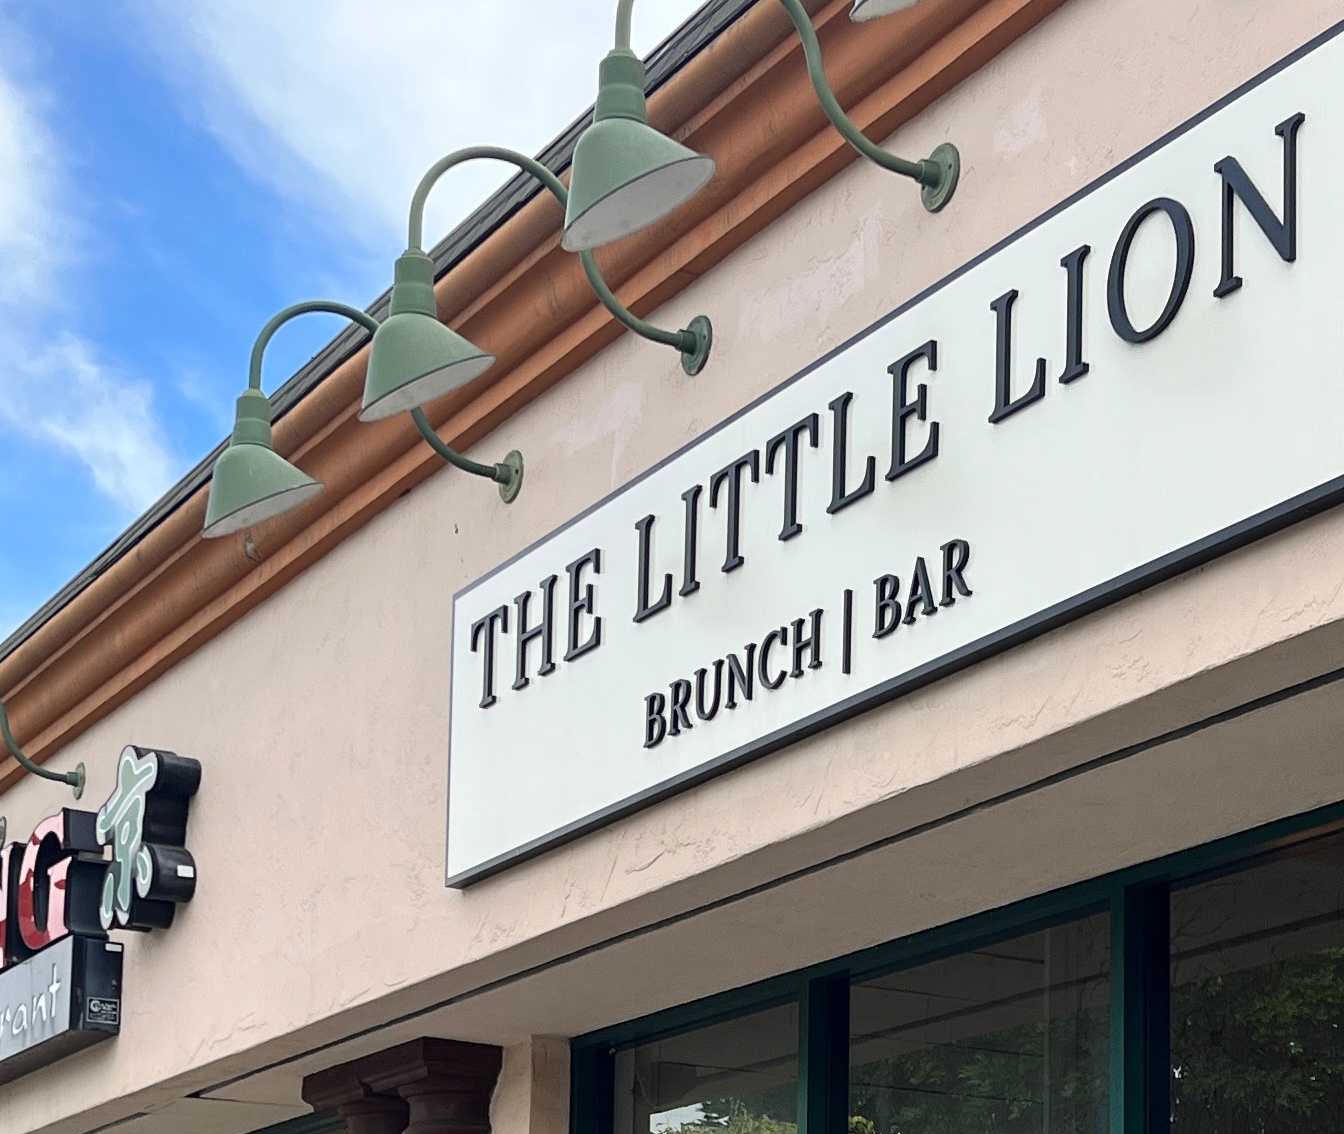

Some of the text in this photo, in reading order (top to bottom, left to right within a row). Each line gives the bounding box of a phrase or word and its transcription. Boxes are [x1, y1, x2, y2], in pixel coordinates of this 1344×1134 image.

[470, 112, 1308, 709] THE LITTLE LION
[643, 608, 824, 748] BRUNCH
[872, 539, 973, 639] BAR
